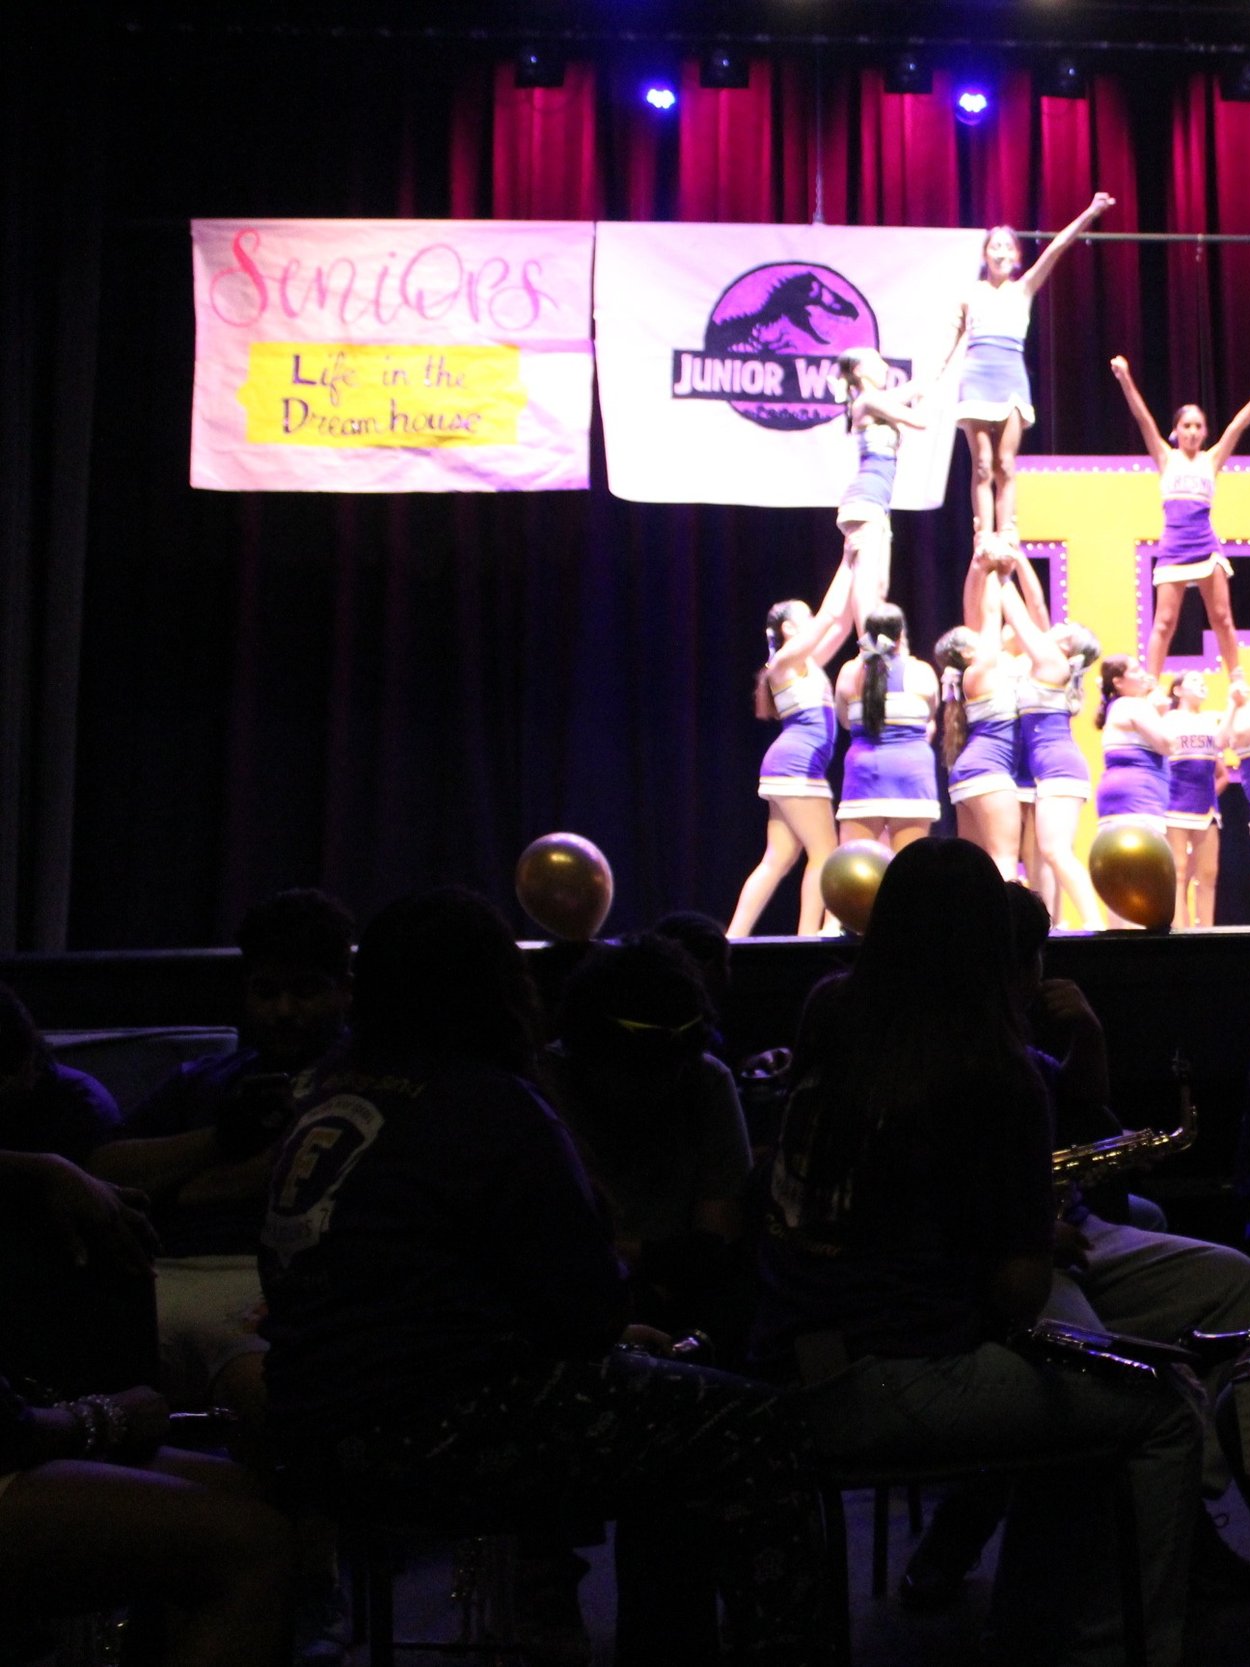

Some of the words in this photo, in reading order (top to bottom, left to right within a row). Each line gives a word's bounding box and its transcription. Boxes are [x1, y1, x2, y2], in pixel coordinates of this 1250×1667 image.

[292, 351, 355, 407] Life
[382, 355, 408, 387] in
[424, 355, 466, 388] the
[673, 353, 785, 396] JUNIOR
